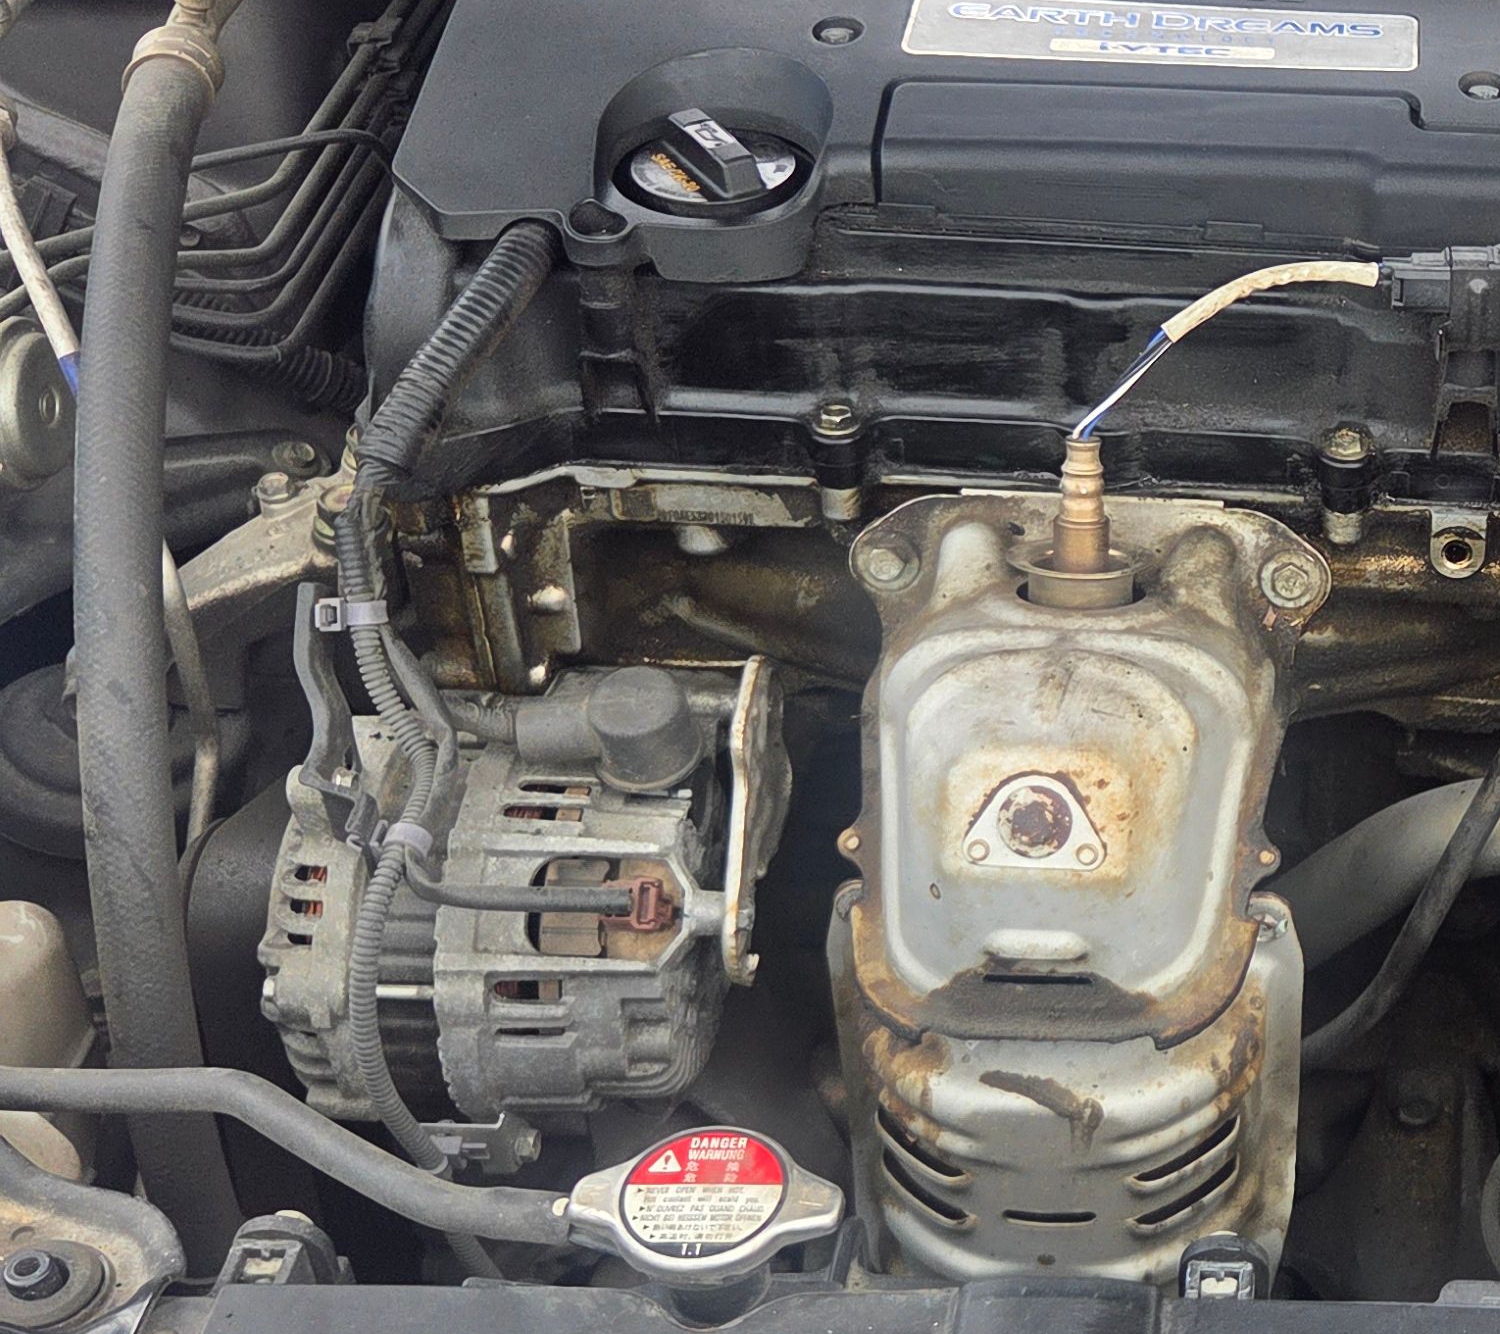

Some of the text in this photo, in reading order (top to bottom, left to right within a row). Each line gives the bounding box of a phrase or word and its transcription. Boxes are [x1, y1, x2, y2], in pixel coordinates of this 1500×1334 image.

[948, 2, 1384, 39] EARTH DREAMS
[690, 1137, 748, 1149] DANGER
[688, 1149, 746, 1160] WARNUNG
[680, 1243, 702, 1256] 1.1
